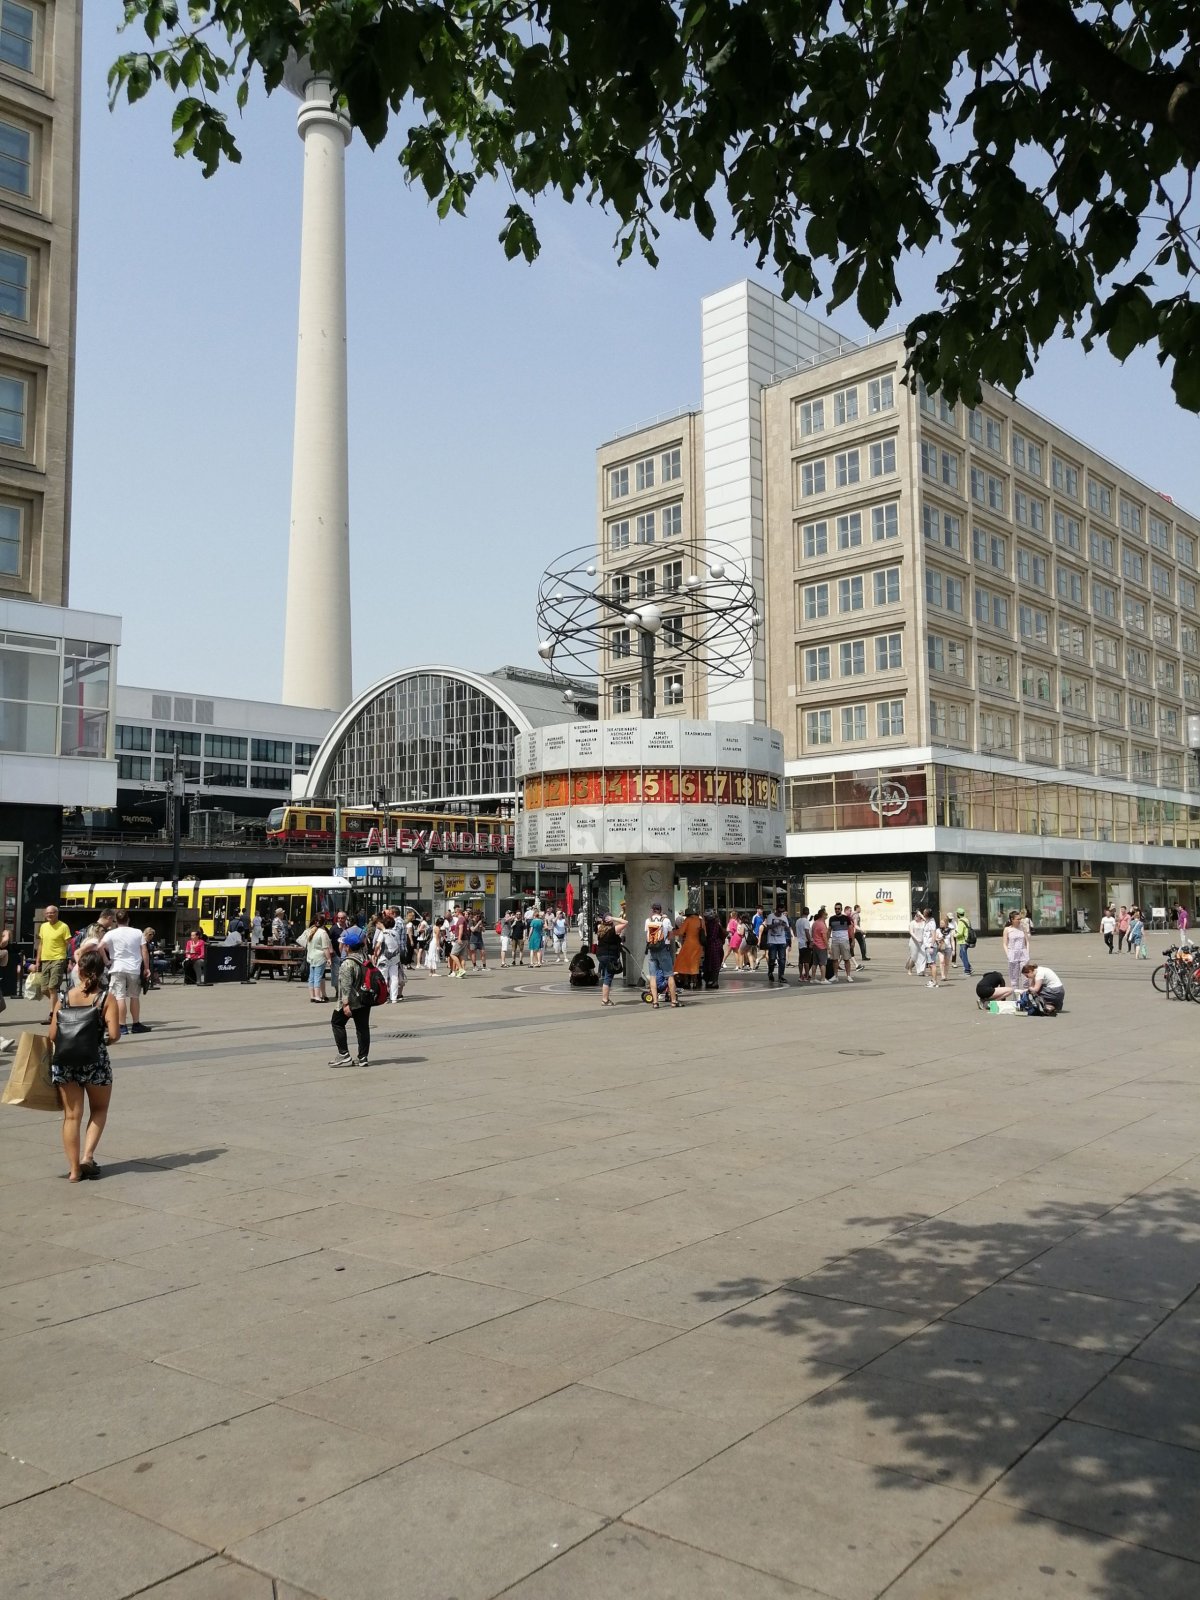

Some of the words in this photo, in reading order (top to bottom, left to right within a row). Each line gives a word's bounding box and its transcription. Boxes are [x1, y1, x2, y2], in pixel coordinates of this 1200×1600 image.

[544, 779, 561, 801] 12
[570, 776, 589, 799] 13
[600, 774, 623, 798] 14
[632, 774, 659, 797] 15
[669, 774, 696, 797] 16
[704, 775, 728, 798] 17
[734, 778, 752, 799] 18
[756, 779, 769, 801] 19
[875, 888, 892, 899] dm
